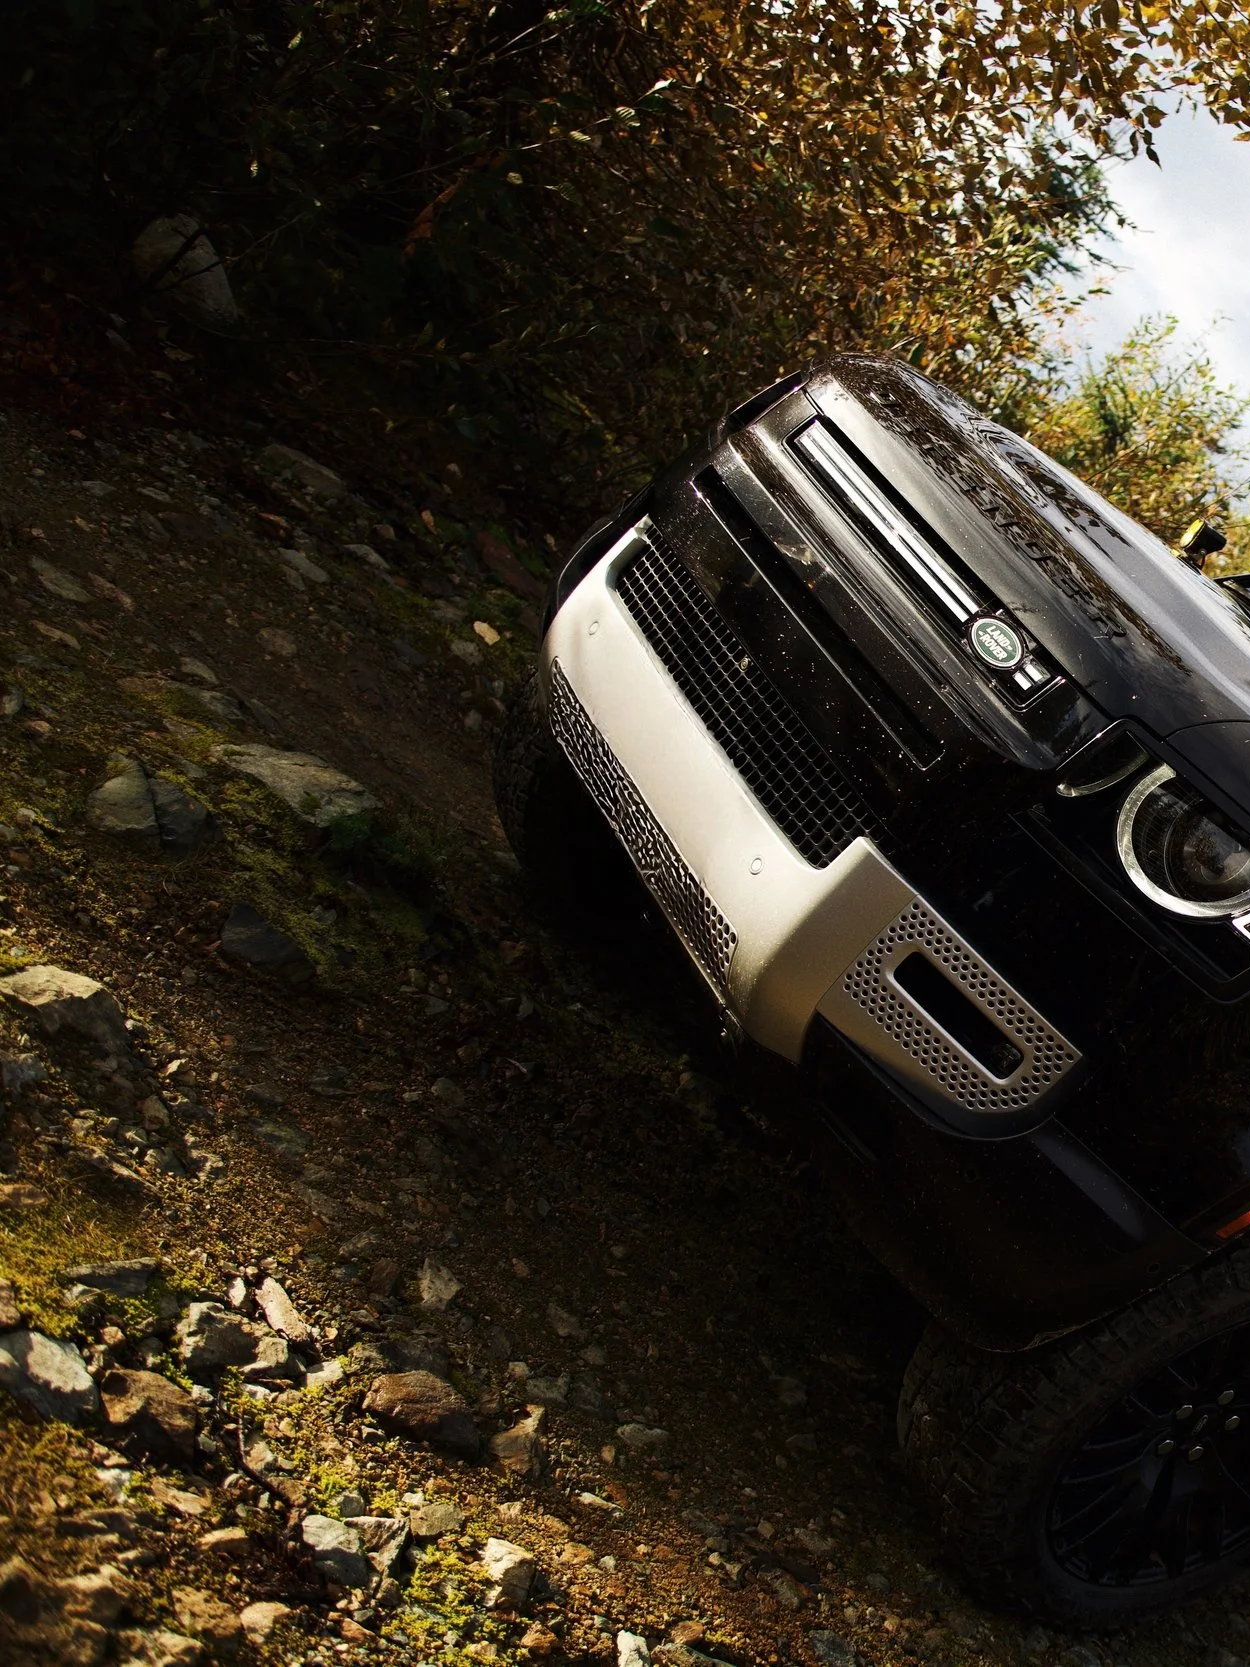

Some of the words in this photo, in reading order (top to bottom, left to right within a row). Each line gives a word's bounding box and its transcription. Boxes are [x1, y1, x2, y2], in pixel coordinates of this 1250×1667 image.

[868, 390, 1127, 639] DEFENDER
[980, 633, 1008, 660] ROVER
[986, 625, 1010, 648] LAND
